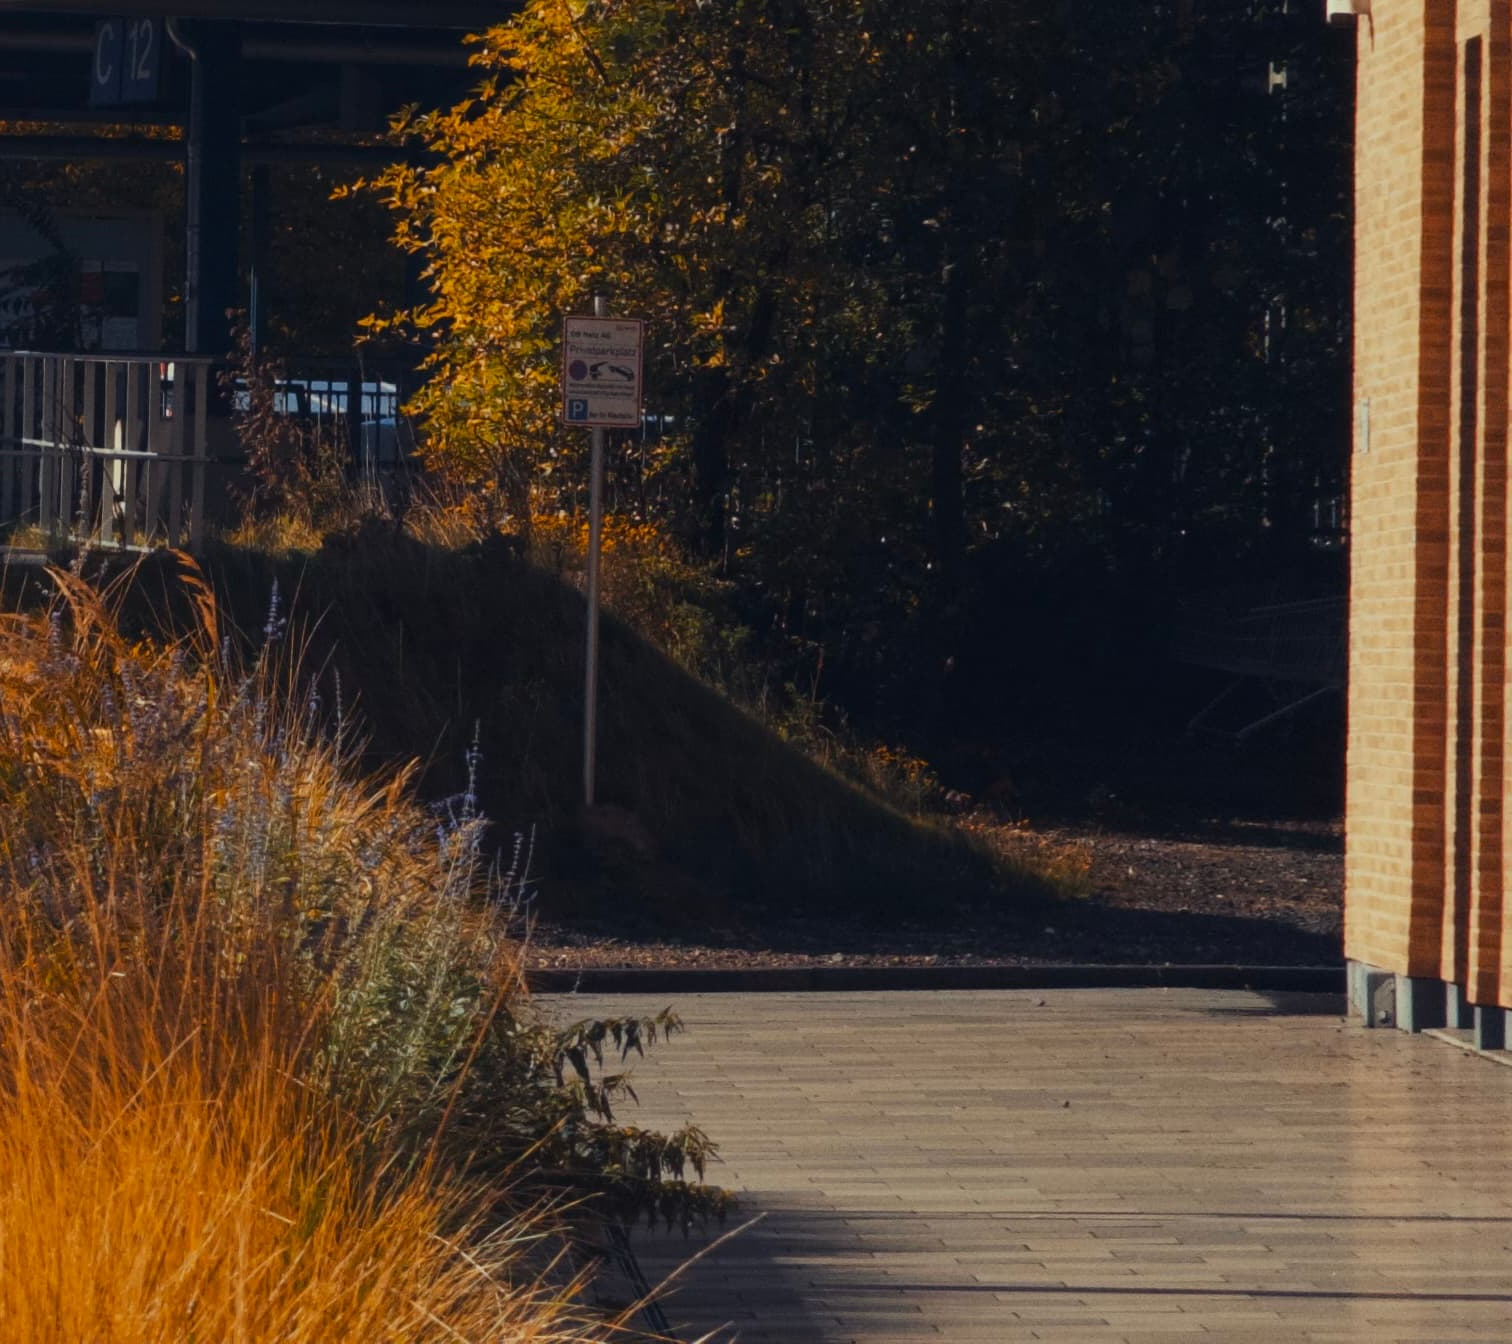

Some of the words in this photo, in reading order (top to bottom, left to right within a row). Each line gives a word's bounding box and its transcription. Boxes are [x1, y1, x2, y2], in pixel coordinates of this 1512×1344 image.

[96, 23, 114, 85] C
[129, 19, 153, 81] 12
[572, 400, 584, 418] P
